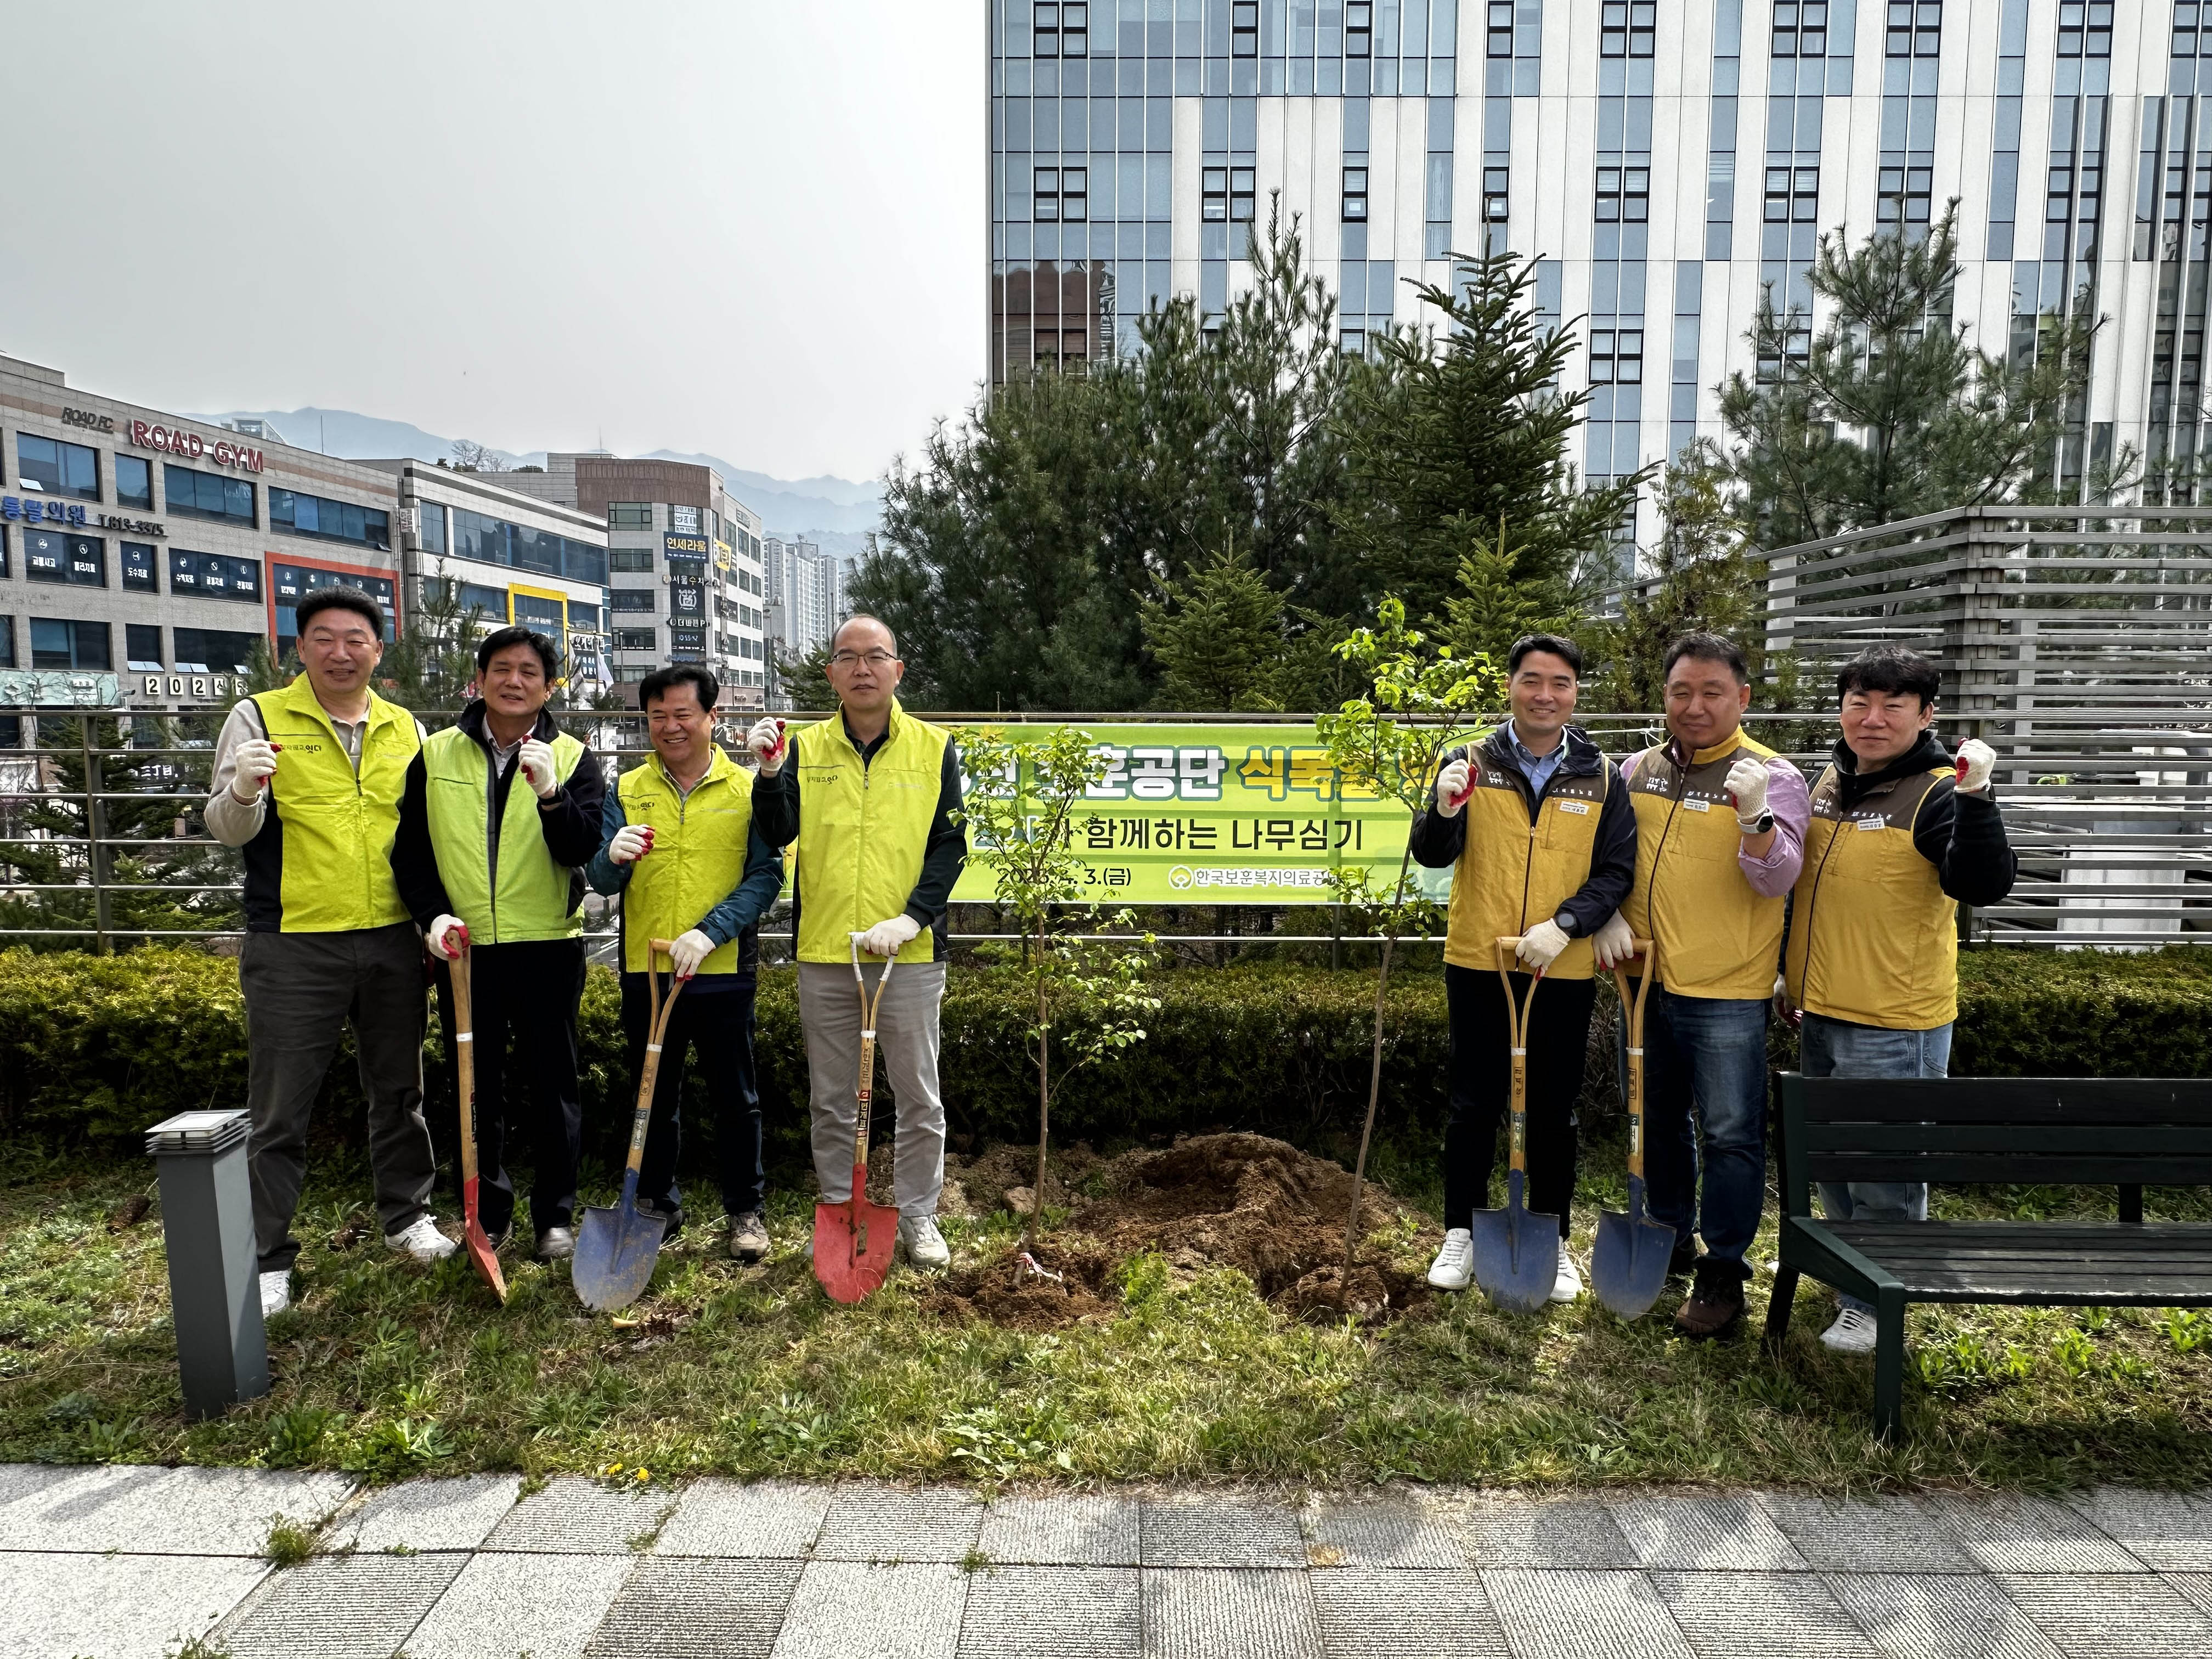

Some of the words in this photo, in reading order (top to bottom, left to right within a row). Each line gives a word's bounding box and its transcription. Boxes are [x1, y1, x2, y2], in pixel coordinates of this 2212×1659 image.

[62, 407, 97, 425] ROAD
[99, 415, 113, 428] FC
[132, 419, 204, 459] ROAD
[213, 441, 264, 473] GYM
[1035, 746, 1226, 799] 훈공단
[1086, 818, 1217, 850] 함께하는
[1232, 819, 1362, 851] 나무심기
